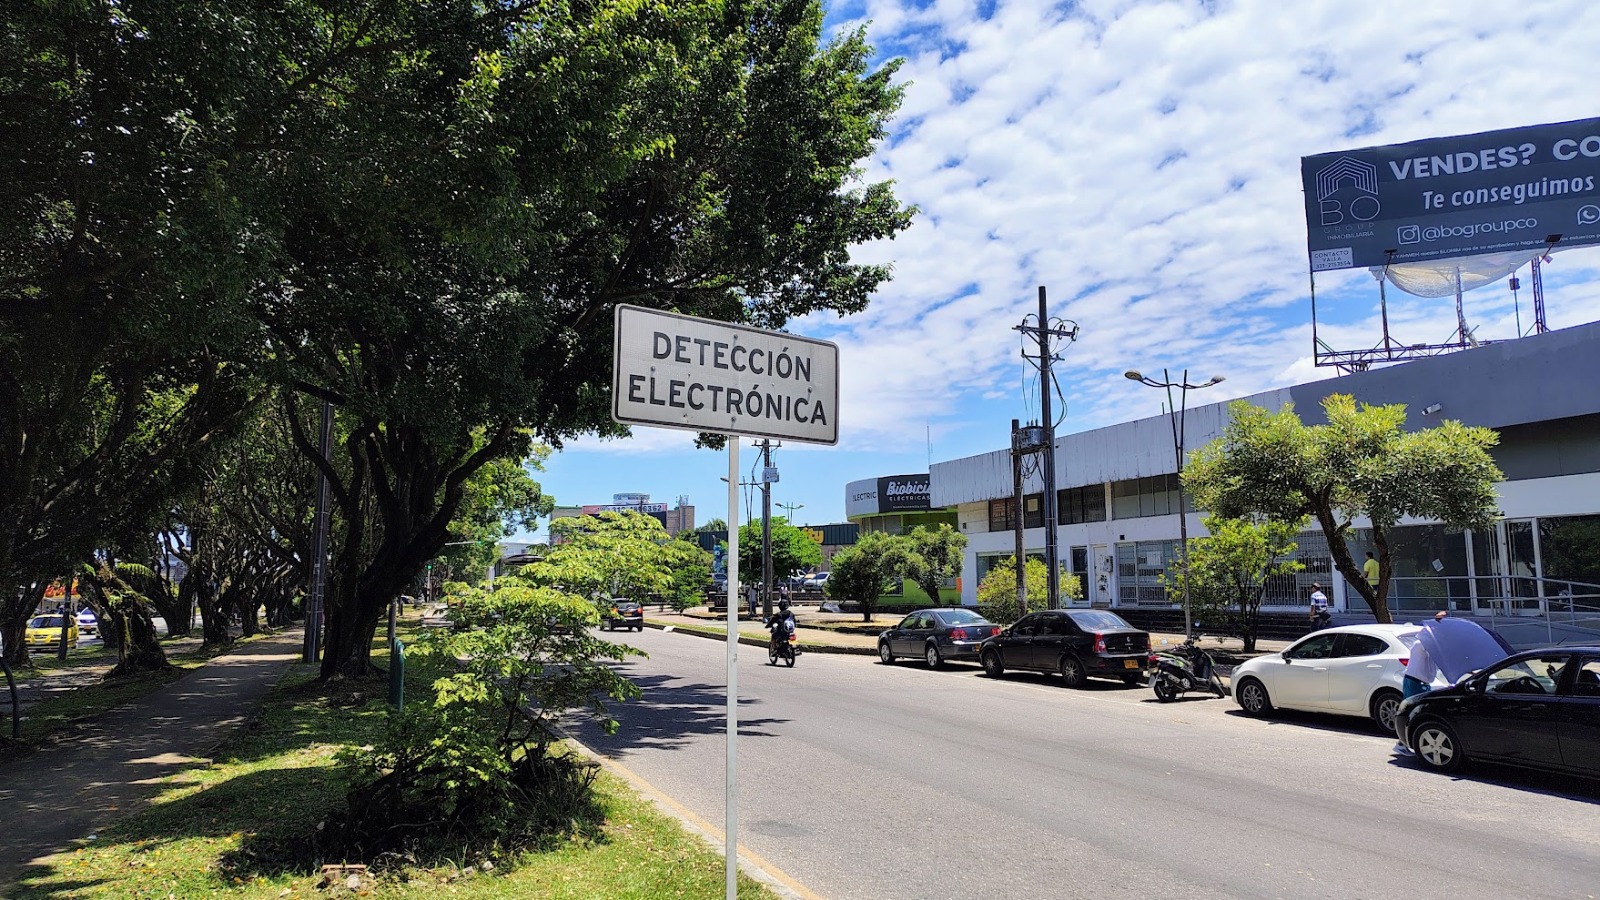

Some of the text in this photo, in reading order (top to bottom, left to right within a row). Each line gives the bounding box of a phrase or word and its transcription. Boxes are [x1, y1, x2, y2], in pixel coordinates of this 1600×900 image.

[1388, 135, 1600, 181] VENDES? CO
[1422, 175, 1595, 210] Te conseguimos
[1320, 195, 1381, 226] BO
[1323, 222, 1375, 234] GROUP
[1327, 231, 1374, 240] INMOBILIARIA
[1422, 217, 1538, 242] @bogroupco
[1314, 250, 1349, 259] CONTACTO
[652, 331, 812, 382] DETECCIÓN
[628, 374, 828, 426] ELECTRÓNICA
